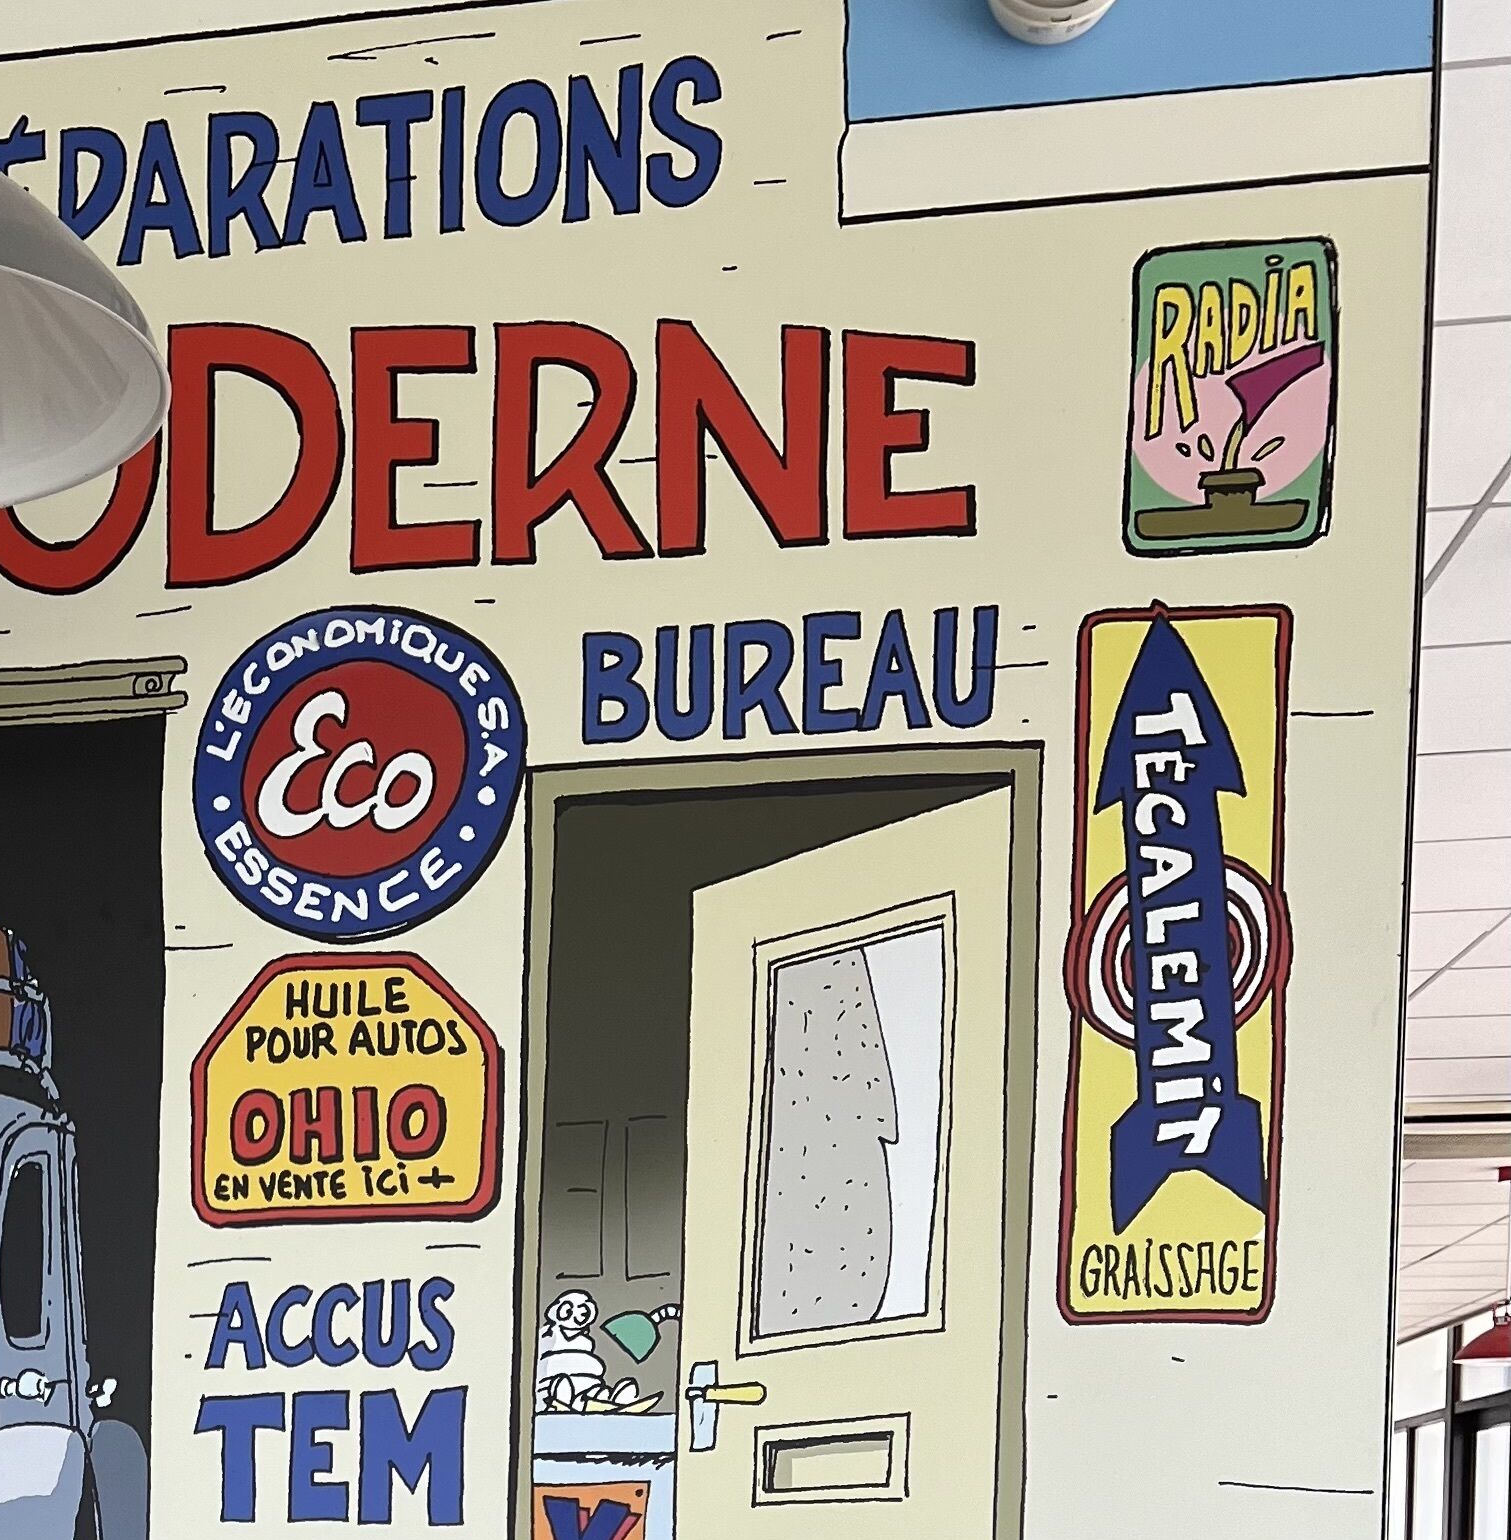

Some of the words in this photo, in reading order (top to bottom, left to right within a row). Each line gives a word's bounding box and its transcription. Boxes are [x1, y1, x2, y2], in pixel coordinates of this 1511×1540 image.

[582, 604, 999, 744] BUREAU
[255, 686, 437, 839] Eco
[215, 820, 463, 922] ESSENCE
[245, 1022, 338, 1064] POUR
[348, 1018, 468, 1056] AUTOS
[285, 976, 411, 1020] HUILE
[230, 1083, 448, 1167] OHIO
[213, 1173, 250, 1202] EN
[258, 1168, 348, 1202] VENTE
[204, 1276, 456, 1371] ACCUS
[193, 1385, 469, 1526] TEM
